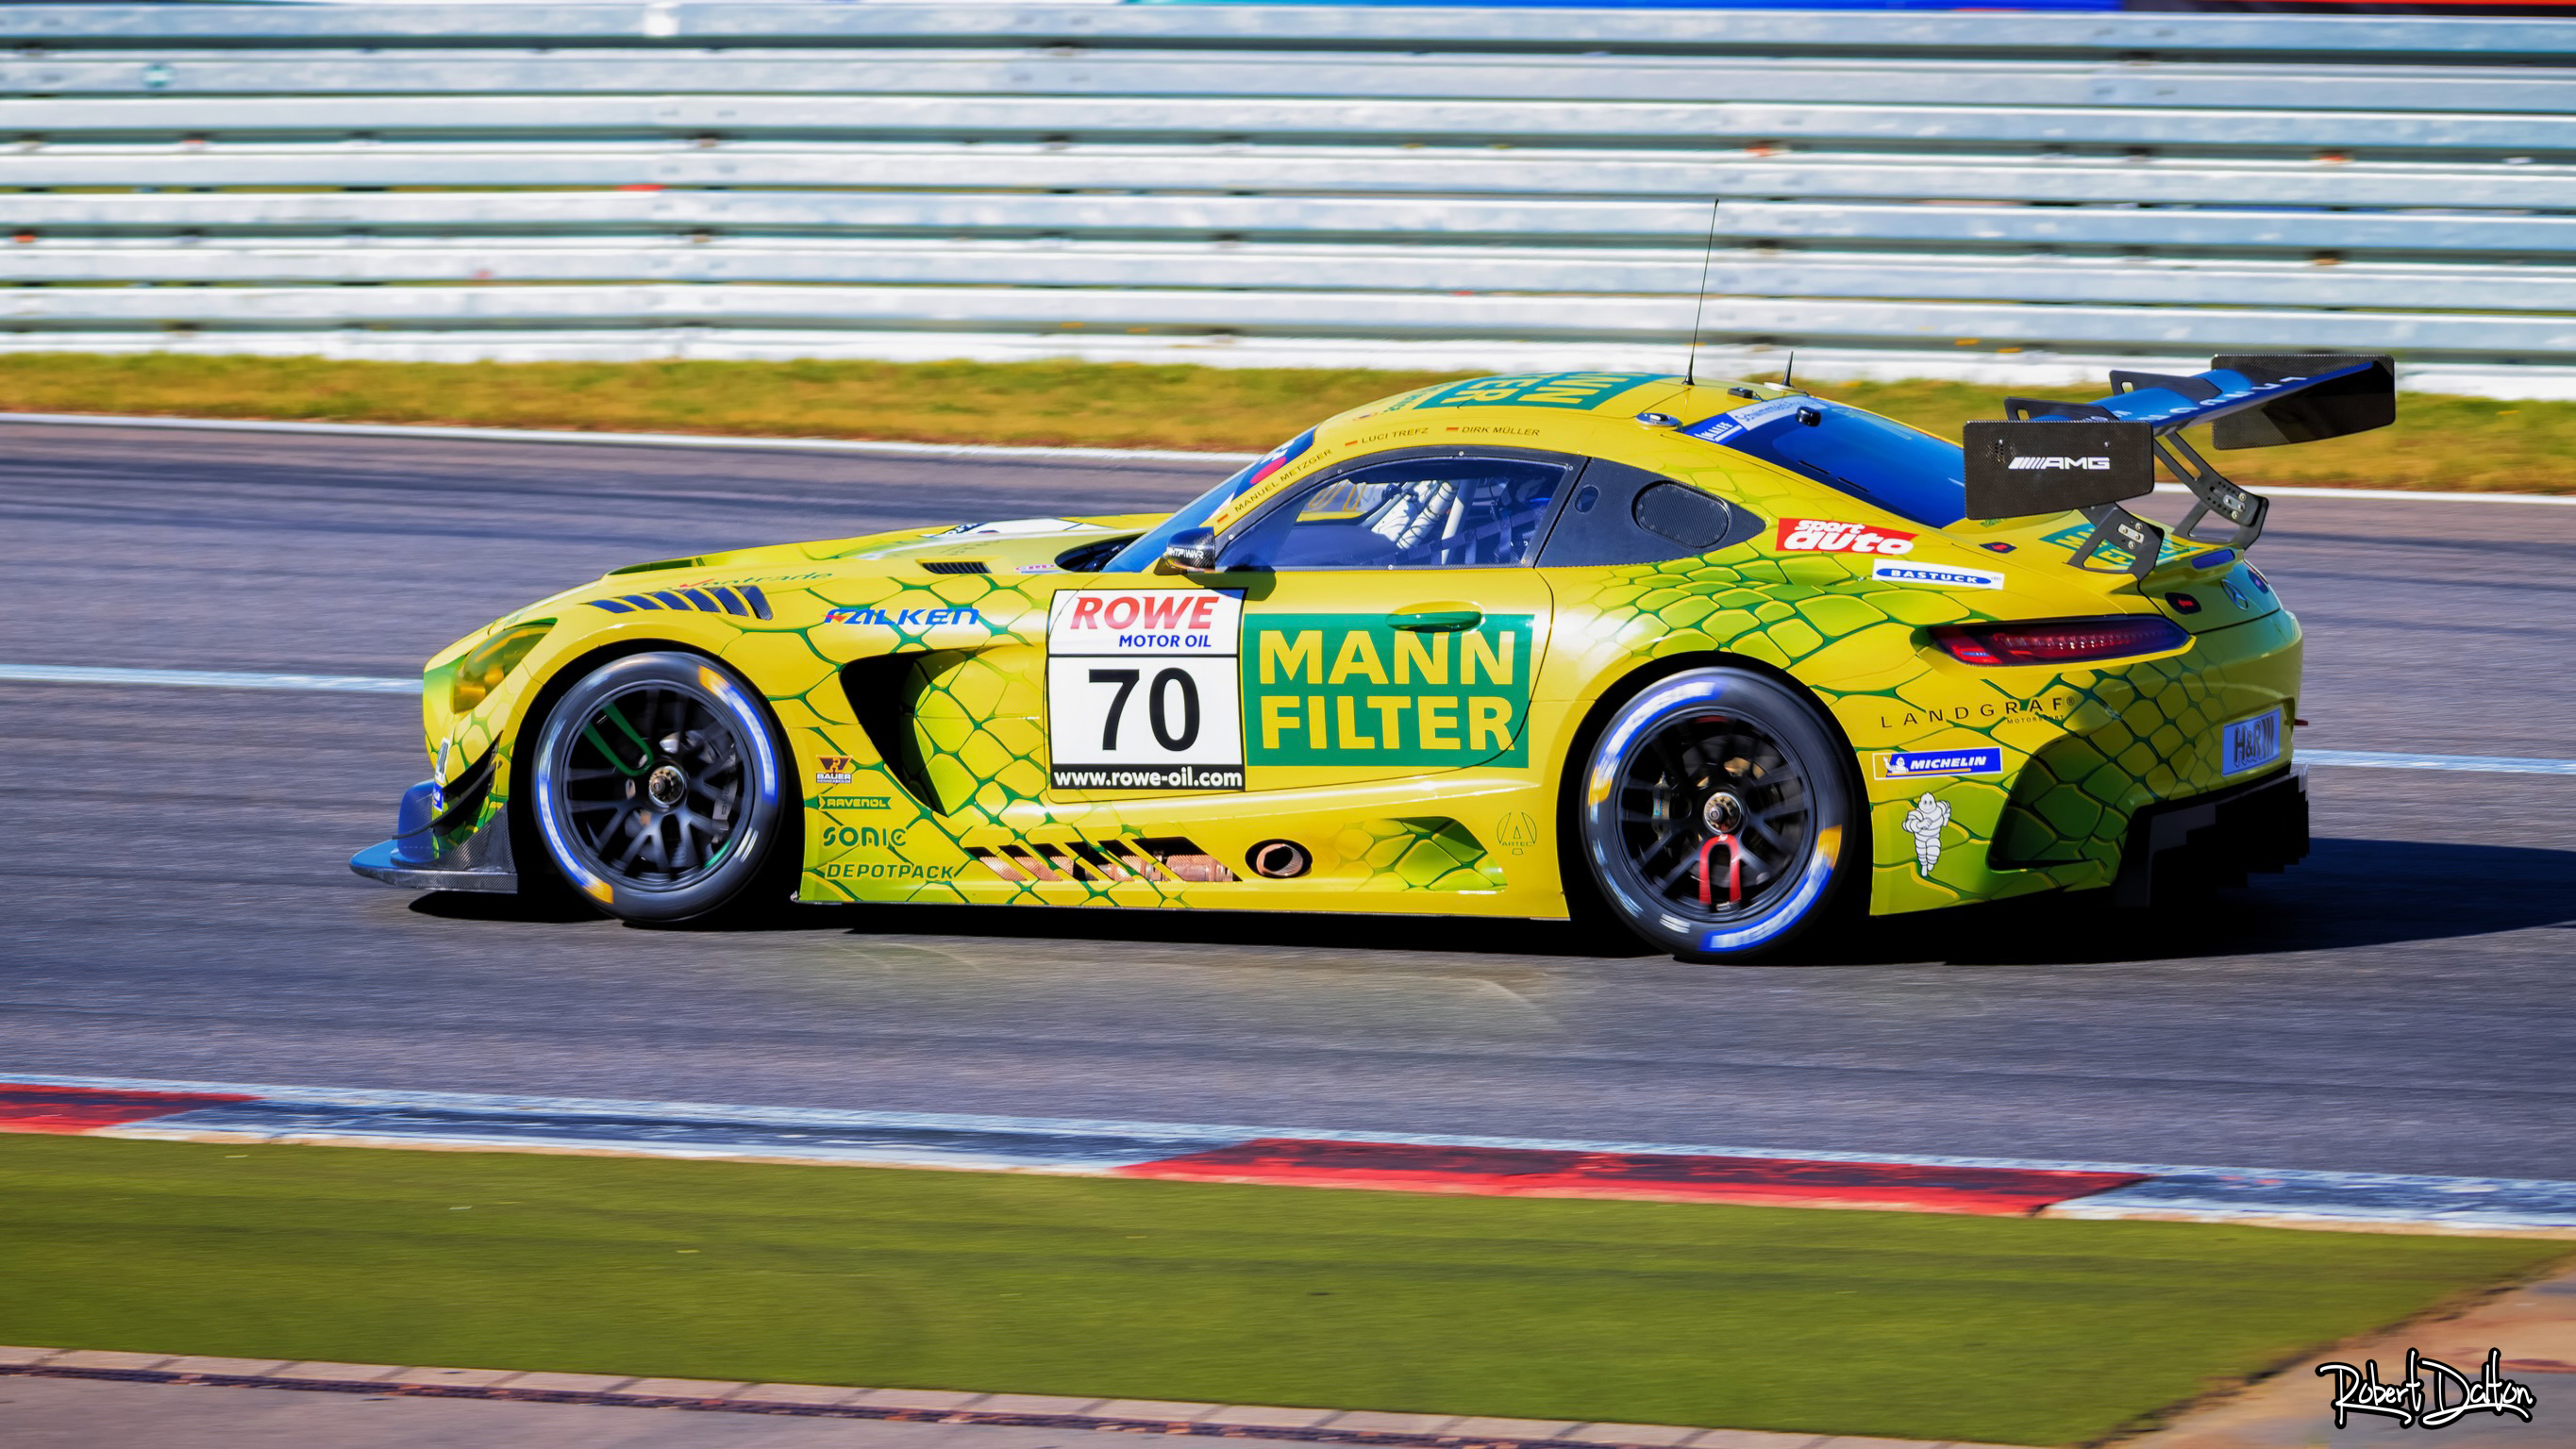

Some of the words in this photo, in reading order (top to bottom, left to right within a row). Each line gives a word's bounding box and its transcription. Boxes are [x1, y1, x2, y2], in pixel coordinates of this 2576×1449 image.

[1361, 434, 1391, 444] LUCI
[1392, 426, 1430, 440] TREFZ
[1461, 426, 1490, 435] DIRK
[1492, 426, 1541, 437] MÜLLER
[2041, 457, 2111, 470] AMG
[1234, 482, 1280, 512] MANUEL
[1280, 448, 1334, 482] METZGER
[1794, 520, 1865, 534] sport
[1783, 530, 1915, 555] auto
[1890, 569, 1980, 584] BASTUCK
[823, 608, 980, 625] FALKEN
[1071, 596, 1219, 630] ROWE
[1118, 634, 1180, 649] MOTOR
[1185, 633, 1213, 648] OIL
[1260, 630, 1514, 686] MANN
[1088, 667, 1200, 752] 70
[1260, 695, 1515, 751] FILTER
[1910, 756, 1987, 770] MICHELIN
[1053, 767, 1244, 789] www.rowe-oil.com
[827, 798, 887, 808] RAVENOL
[823, 826, 907, 847] SONIC
[827, 863, 954, 879] DEPOTPACK
